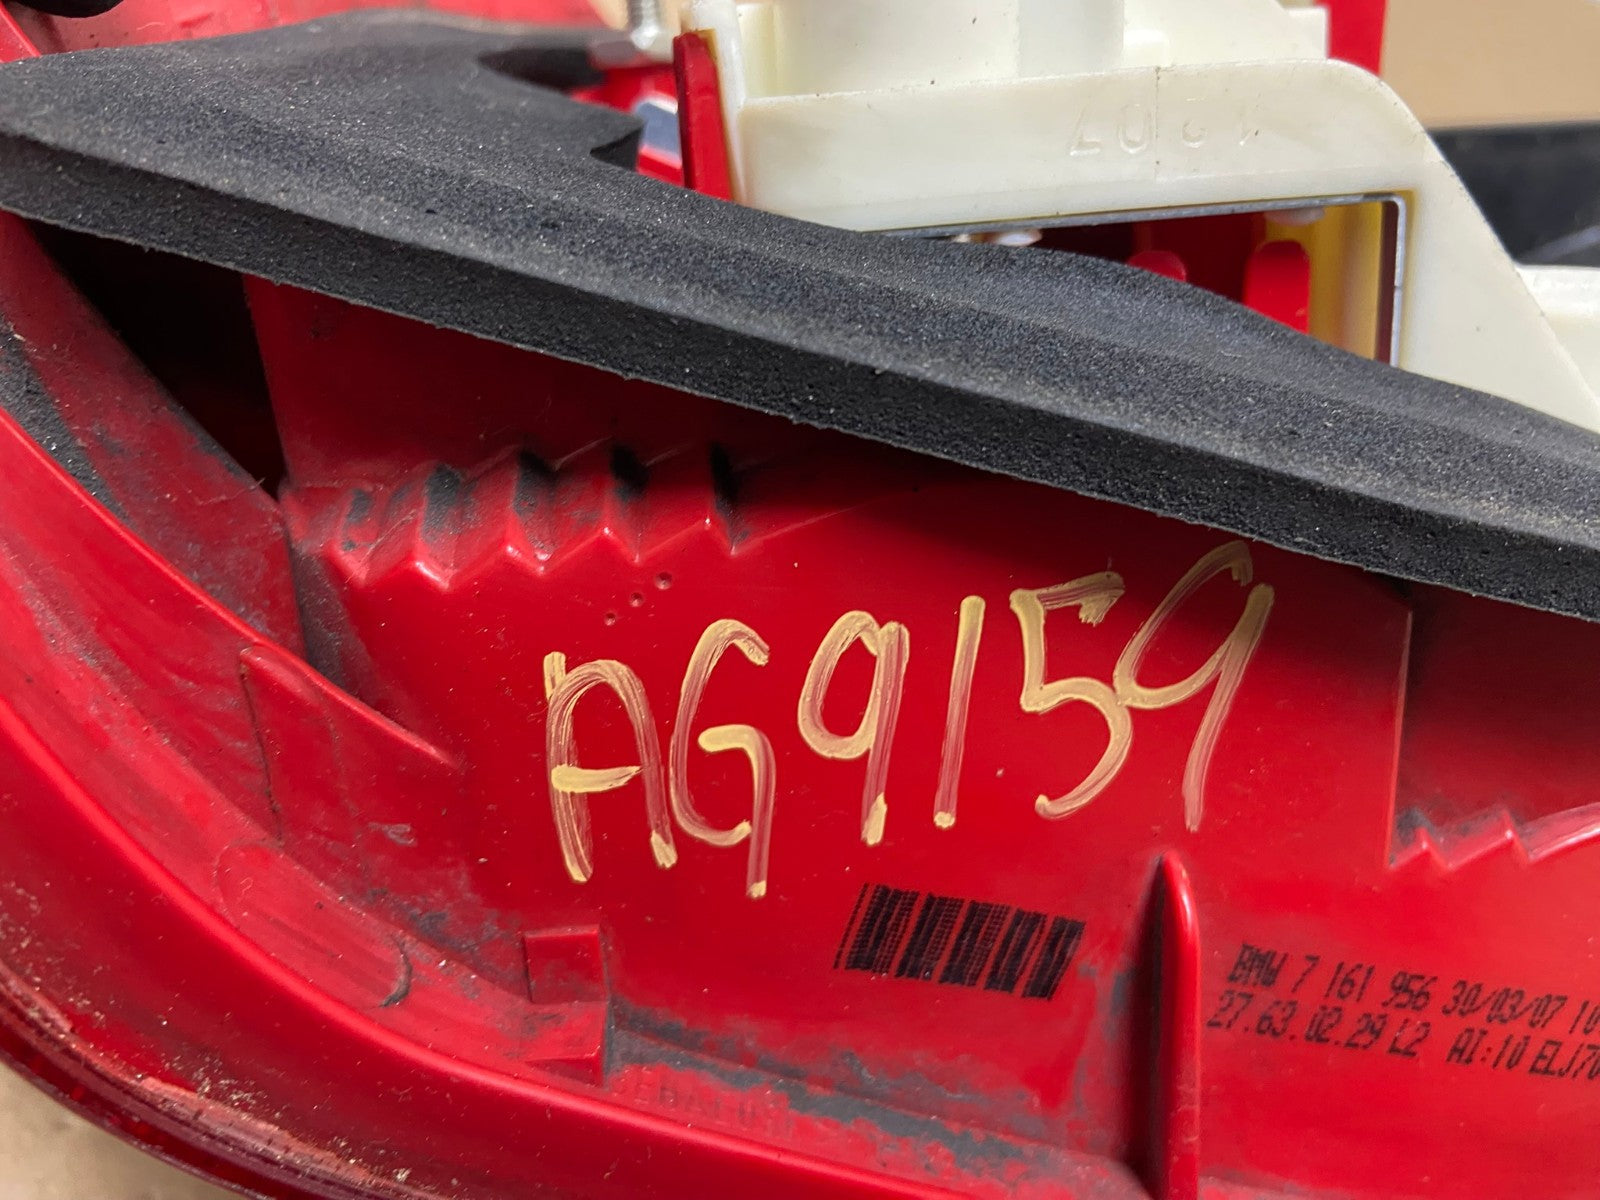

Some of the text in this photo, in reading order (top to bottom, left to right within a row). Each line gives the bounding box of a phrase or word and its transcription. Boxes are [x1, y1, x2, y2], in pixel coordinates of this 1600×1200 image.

[1228, 943, 1289, 987] BMW
[1291, 955, 1320, 993] 7
[1325, 961, 1375, 1002] 161
[1381, 971, 1438, 1011] 956
[1441, 979, 1568, 1028] 30/03/07
[1206, 990, 1388, 1049] 27.63.02.29
[1388, 1018, 1431, 1058] L2
